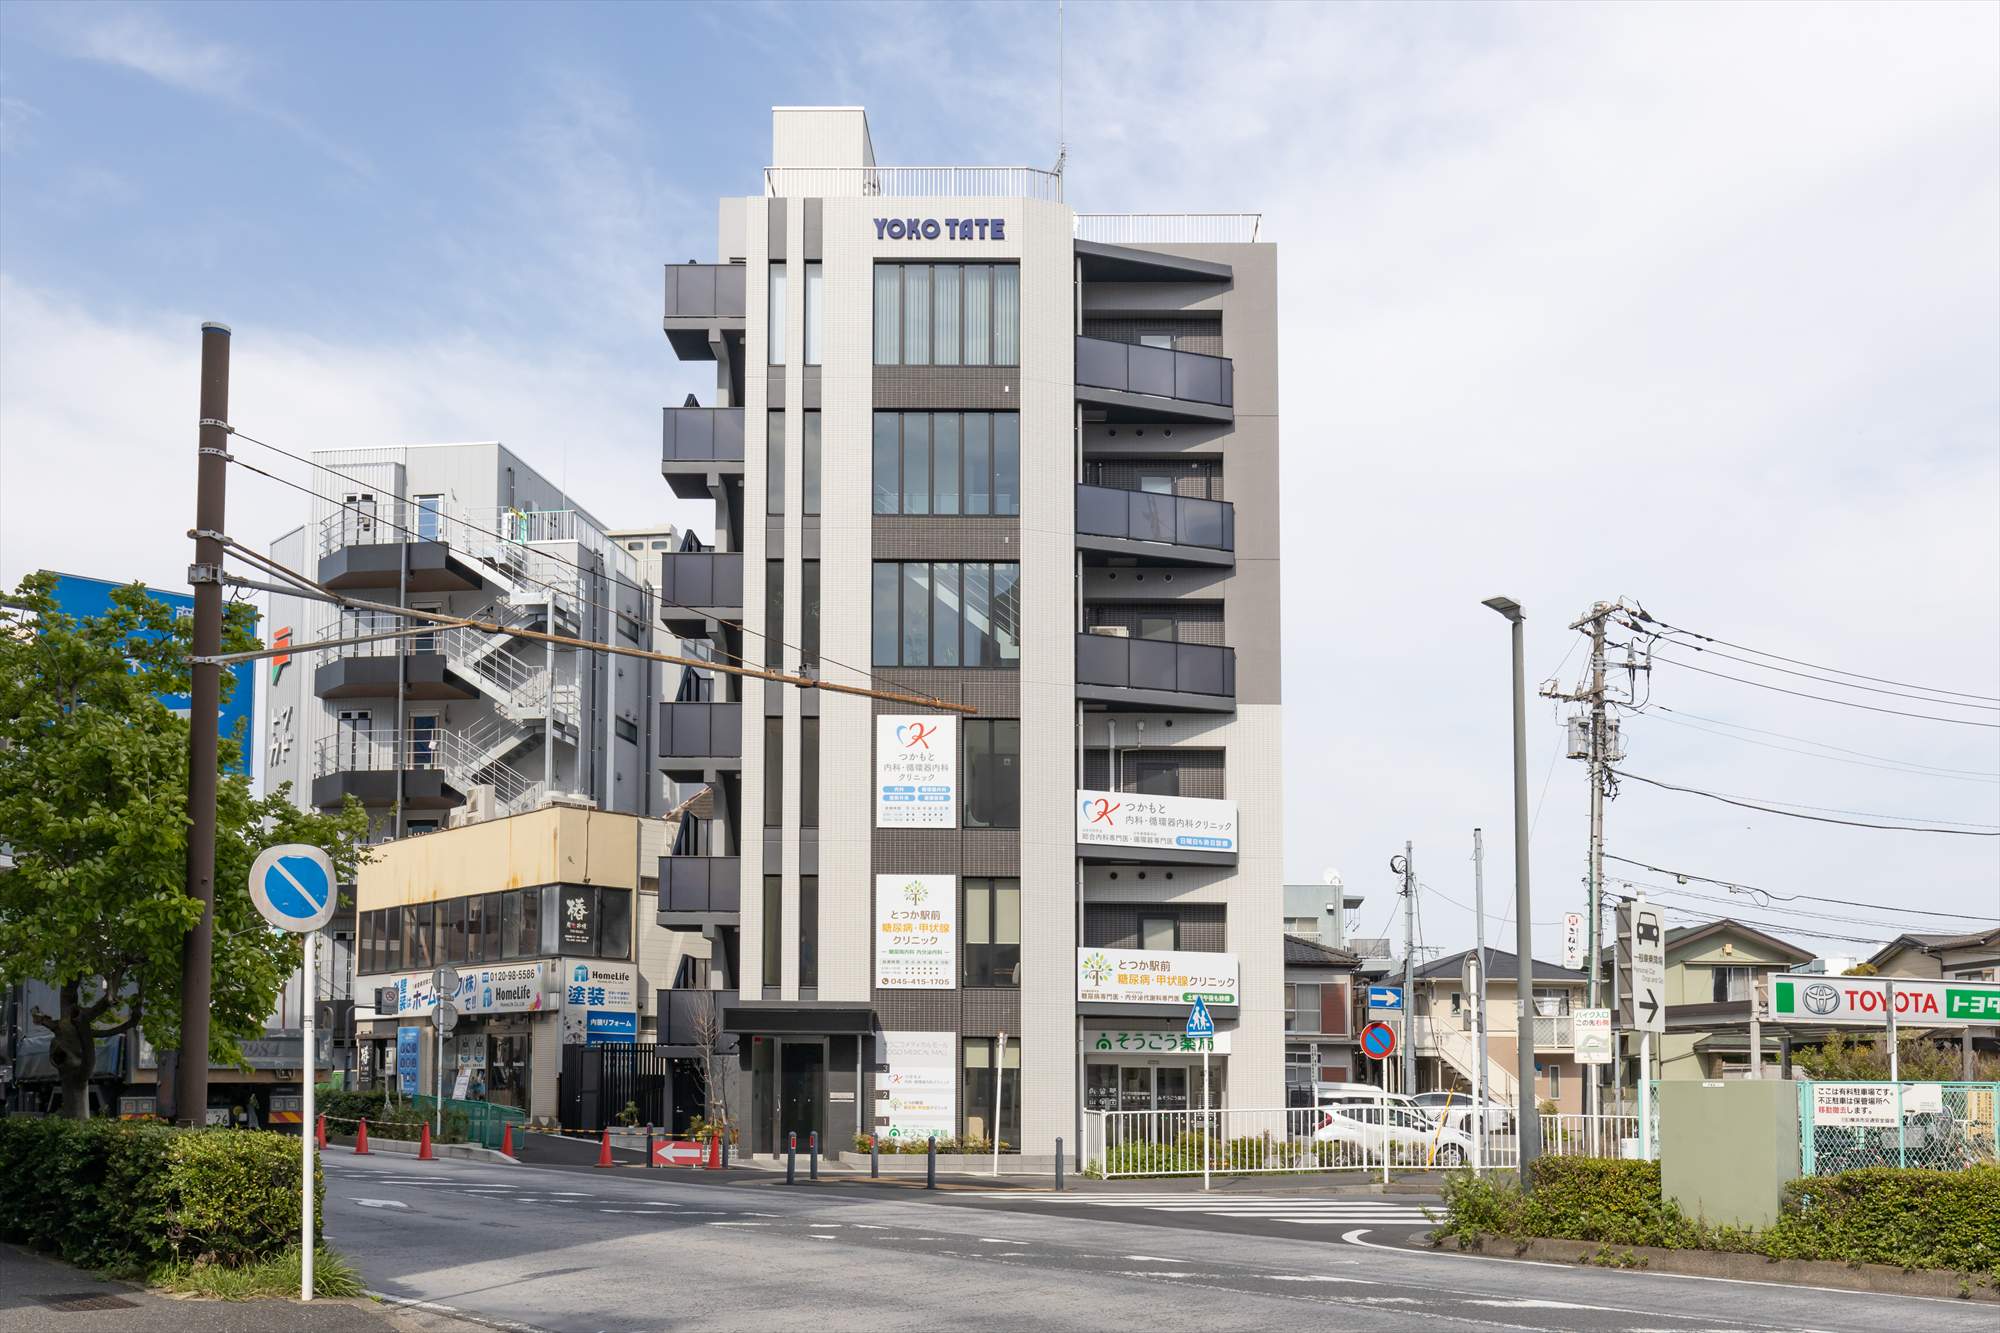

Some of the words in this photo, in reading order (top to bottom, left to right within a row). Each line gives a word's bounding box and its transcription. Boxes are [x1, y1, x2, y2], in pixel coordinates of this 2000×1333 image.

[873, 218, 941, 240] YOKO
[945, 218, 1005, 240] TATE
[898, 752, 935, 761] つかもと
[898, 774, 935, 782] クリニック
[1126, 802, 1167, 814] つかもと
[1125, 815, 1232, 831] 内科・循環器内科クリニック
[890, 910, 941, 921] とつか駅前
[893, 936, 938, 945] クリニック
[1118, 959, 1171, 972] とつか駅前
[490, 969, 535, 982] 0120-98-5586
[592, 971, 630, 981] HomeLife
[495, 984, 531, 1001] HomeLife
[568, 985, 605, 1006] 塗装
[1844, 990, 1939, 1014] TOYOTA
[1952, 995, 2000, 1013] トヨタ
[1818, 1096, 1890, 1105] 不正駐車は保管場所へ
